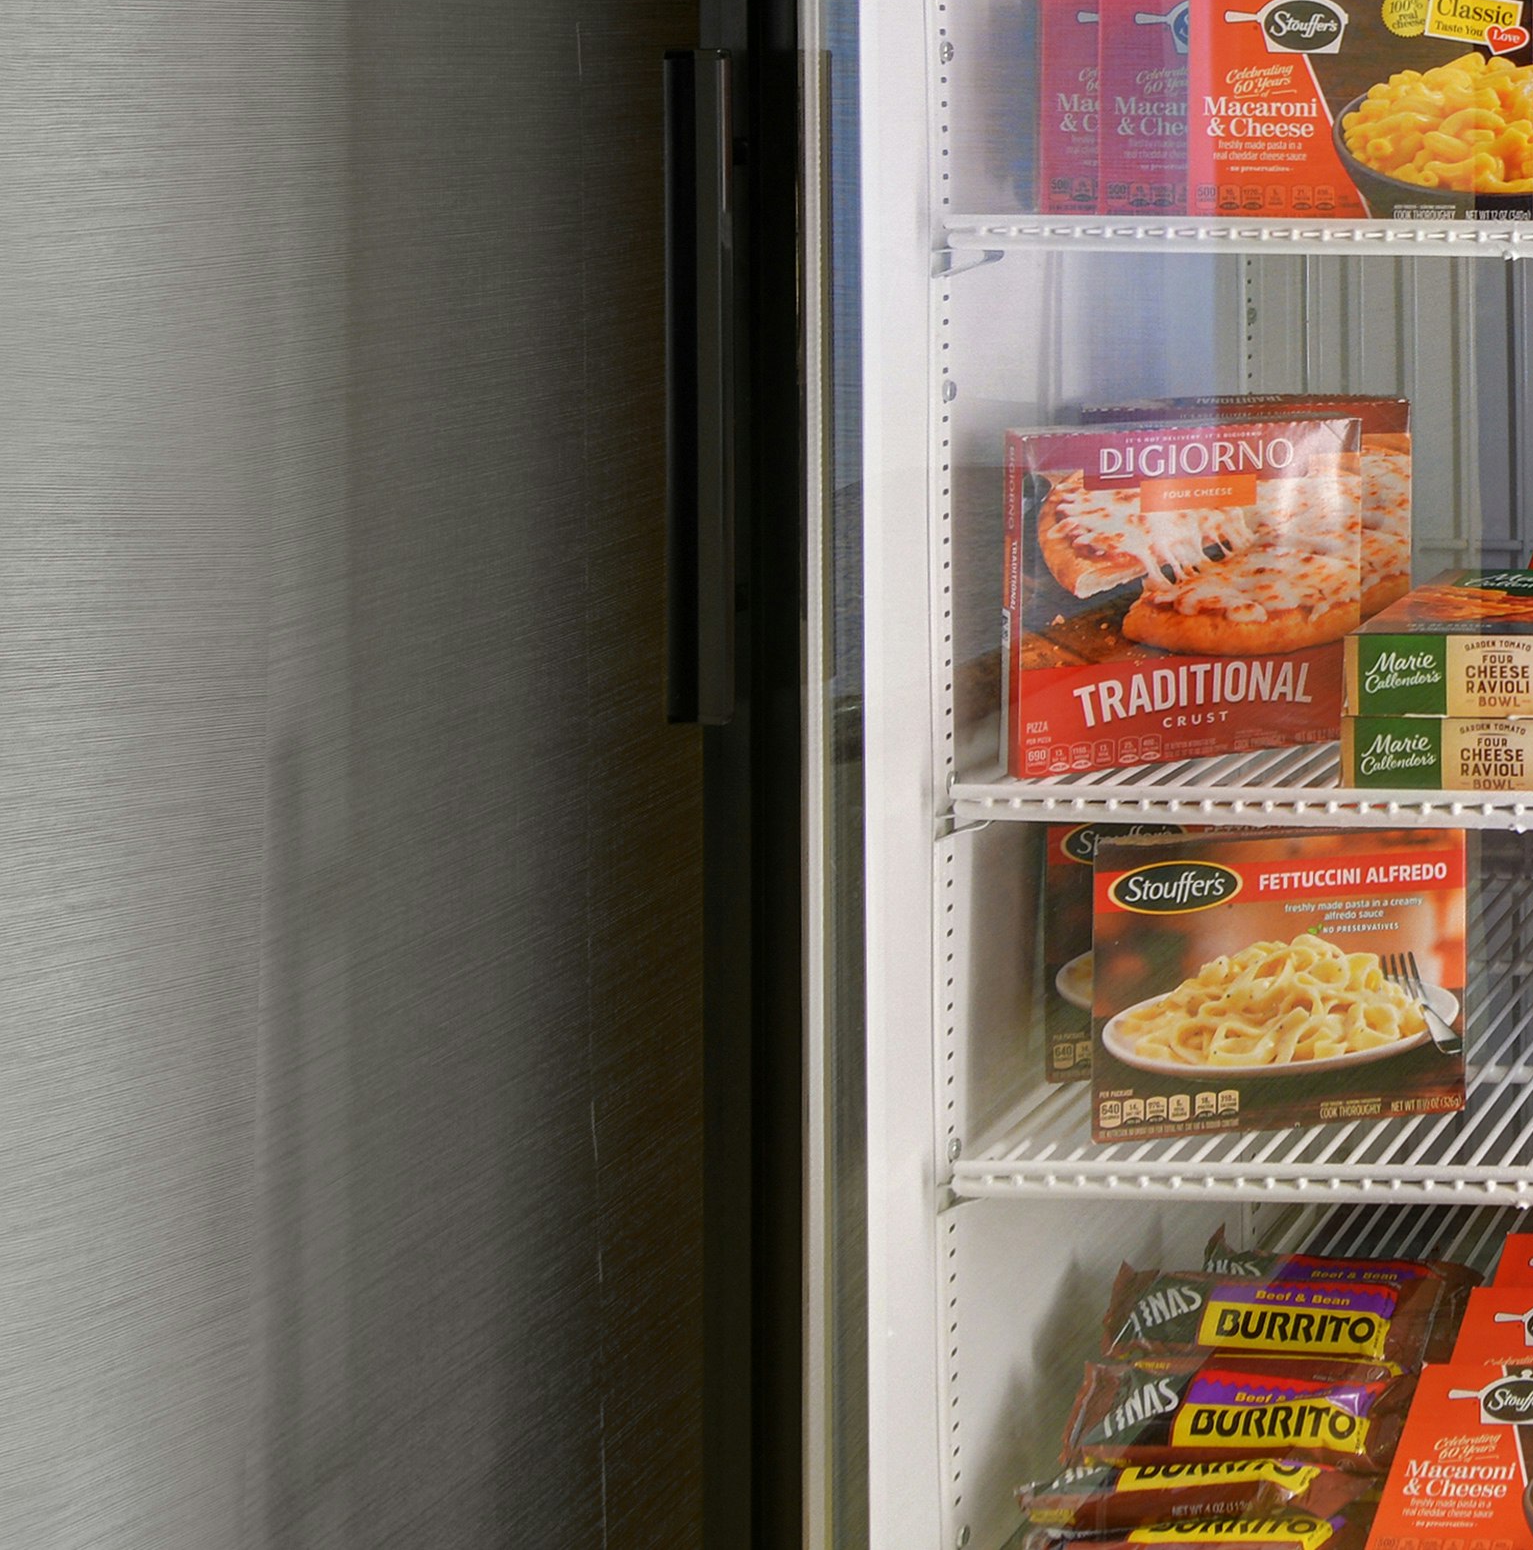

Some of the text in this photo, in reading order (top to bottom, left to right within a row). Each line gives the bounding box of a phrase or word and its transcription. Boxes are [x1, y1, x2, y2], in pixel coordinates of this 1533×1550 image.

[1270, 10, 1338, 39] Stouffer's
[1435, 20, 1483, 37] Taste You
[1493, 29, 1520, 43] Love
[1226, 64, 1294, 84] Celebrating
[1233, 76, 1292, 94] 60 Years
[1203, 97, 1318, 117] Macaroni
[1206, 117, 1314, 137] & Cheese
[1163, 487, 1233, 499] FOUR CHEESE
[1464, 640, 1531, 652] GARDEN TOMATO
[1365, 652, 1437, 676] Marie
[1482, 654, 1513, 664] FOUR
[1465, 665, 1530, 679] CHEESE
[1073, 660, 1313, 727] TRADITIONAL
[1466, 680, 1530, 694] RAVIOLI
[1479, 696, 1520, 707] BOWL
[1163, 710, 1229, 728] CRUST
[1026, 722, 1048, 733] PIZZA
[1459, 723, 1526, 735] GARDEN TOMATO
[1360, 734, 1431, 758] Marie
[1477, 737, 1507, 747] FOUR
[1028, 750, 1046, 762] 690
[1460, 748, 1524, 762] CHEESE
[1460, 763, 1524, 777] RAVIOLI
[1473, 779, 1515, 790] BOWL
[1259, 862, 1448, 891] FETTUCCINI ALFREDO
[1124, 872, 1226, 904] Stouffer's
[1323, 909, 1384, 921] alfredo sauce
[1322, 922, 1400, 934] NO PRESERVATIVES
[1101, 1104, 1120, 1116] 640
[1255, 1290, 1350, 1306] Beef & Bean
[1216, 1308, 1376, 1344] BURRITO
[1235, 1391, 1271, 1404] Beef
[1190, 1405, 1356, 1440] BURRITO
[1434, 1434, 1502, 1450] Celebrating
[1404, 1460, 1516, 1480] Macaroni
[1402, 1478, 1507, 1498] & Cheese
